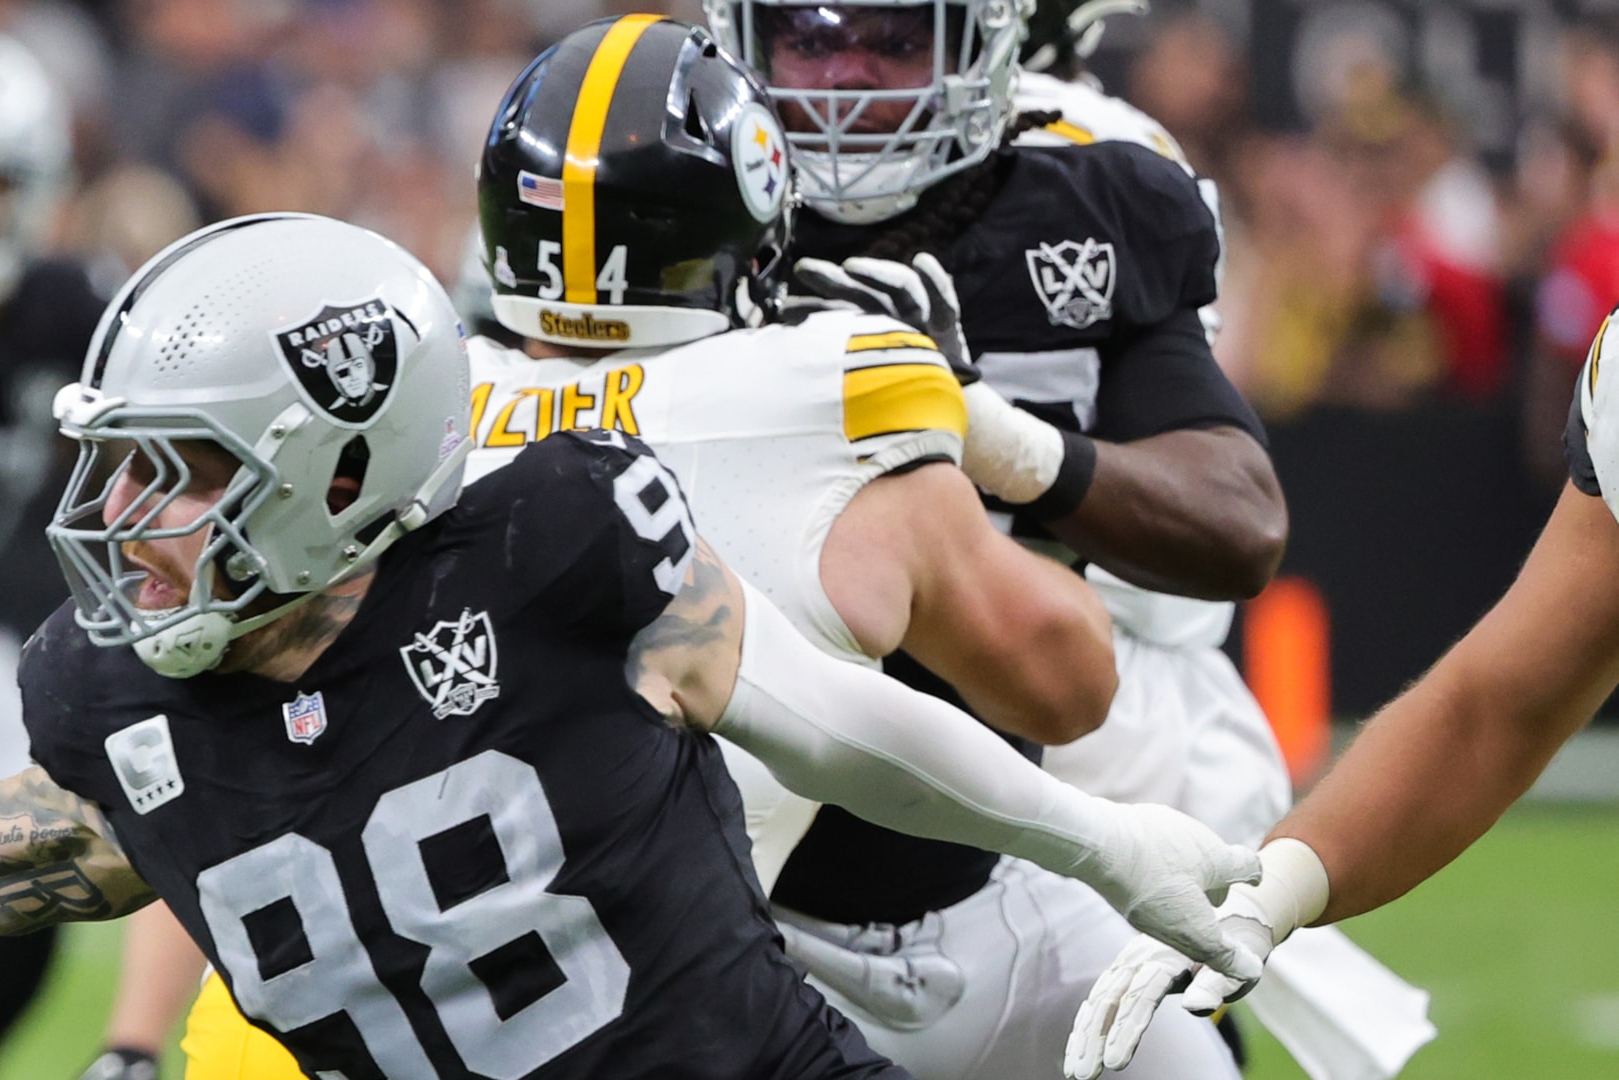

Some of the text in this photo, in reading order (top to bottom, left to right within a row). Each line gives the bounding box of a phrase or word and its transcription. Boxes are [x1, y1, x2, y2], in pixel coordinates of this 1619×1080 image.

[288, 303, 379, 347] RAIDERS
[540, 309, 630, 341] Steelers
[292, 712, 322, 736] NFL
